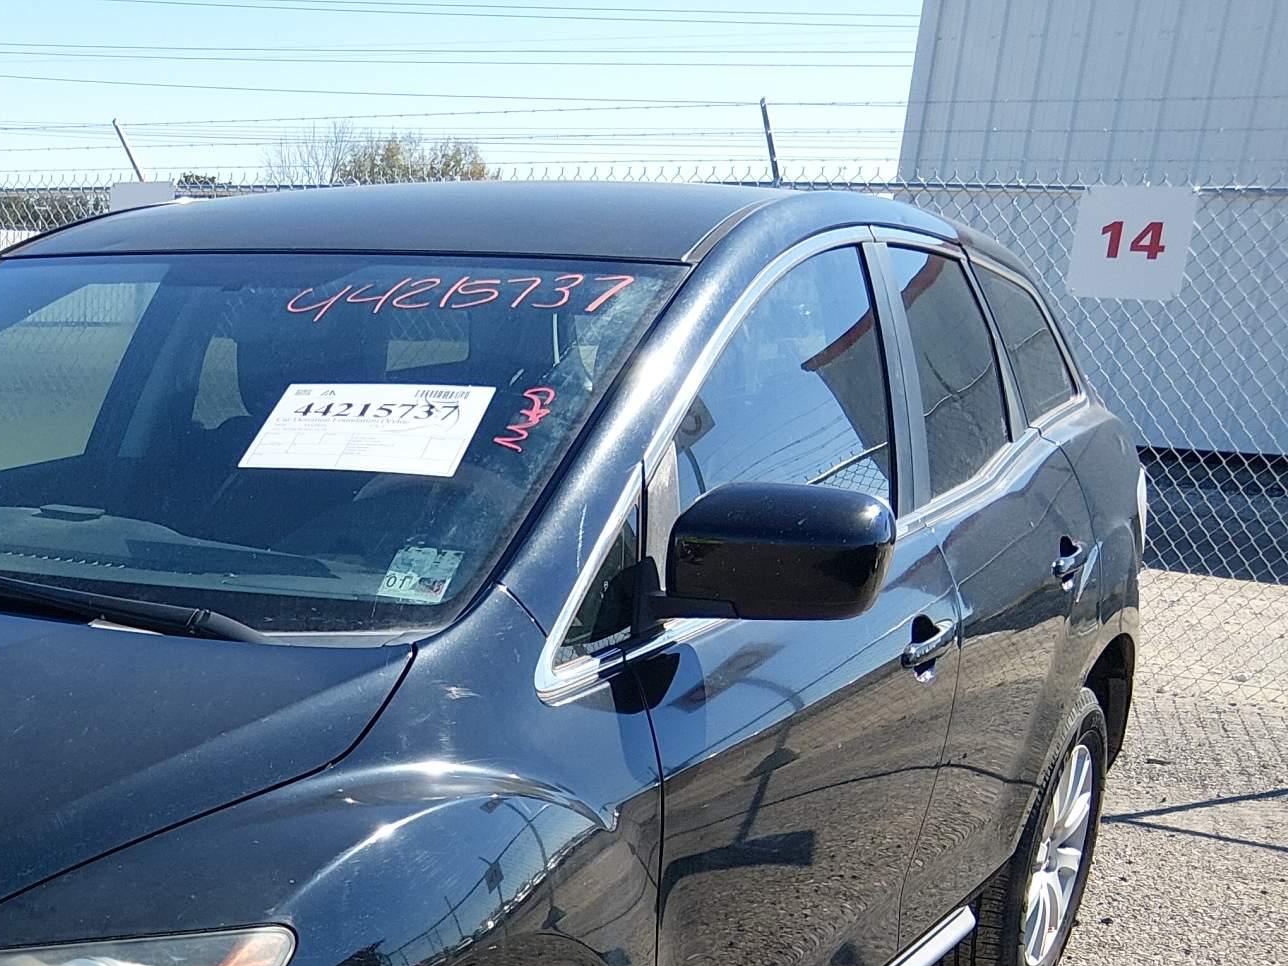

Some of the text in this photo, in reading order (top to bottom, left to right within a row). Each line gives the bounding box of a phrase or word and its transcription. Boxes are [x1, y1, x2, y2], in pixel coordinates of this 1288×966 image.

[1101, 221, 1166, 260] 14
[287, 274, 635, 322] 44215737
[293, 402, 460, 421] 44215737
